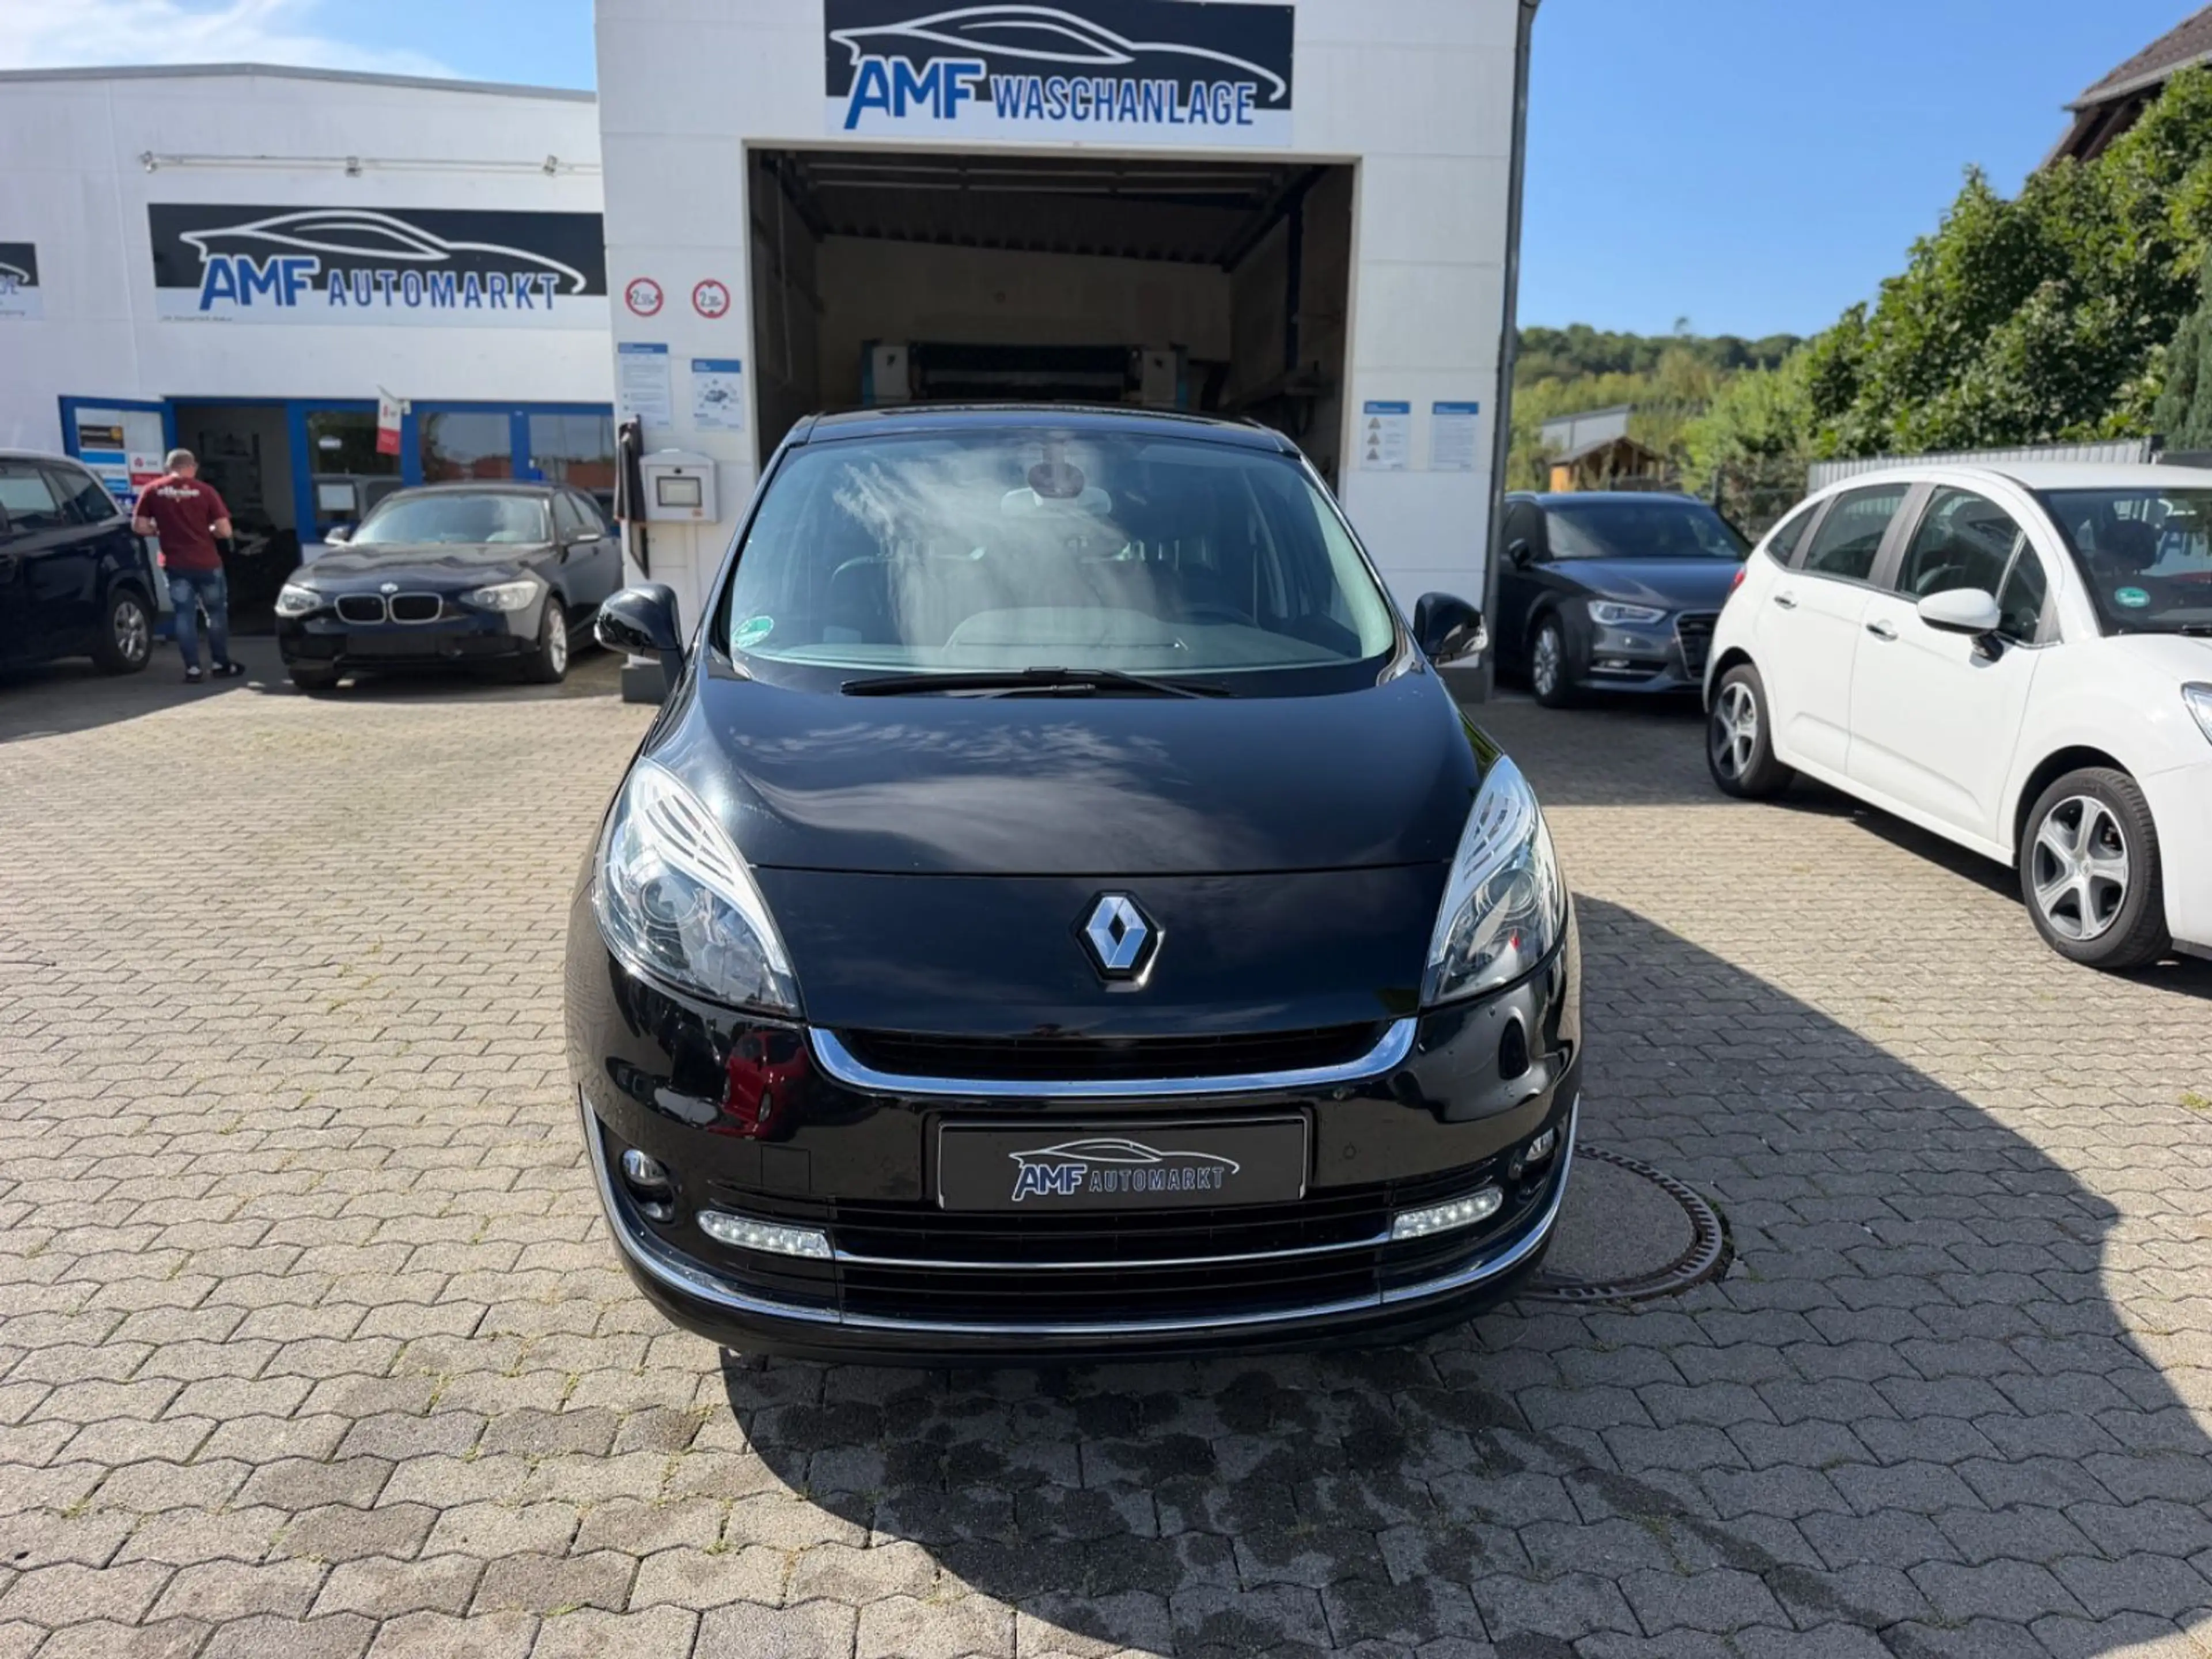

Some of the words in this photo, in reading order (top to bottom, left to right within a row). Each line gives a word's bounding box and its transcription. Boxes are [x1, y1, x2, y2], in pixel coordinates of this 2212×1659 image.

[844, 56, 984, 130] AMF
[993, 76, 1255, 126] WASCHANLAGE
[200, 256, 318, 310] AMF
[328, 269, 559, 310] AUTOMARKT
[1012, 1164, 1087, 1202] AMF
[1089, 1166, 1224, 1192] AUTOMARKT
